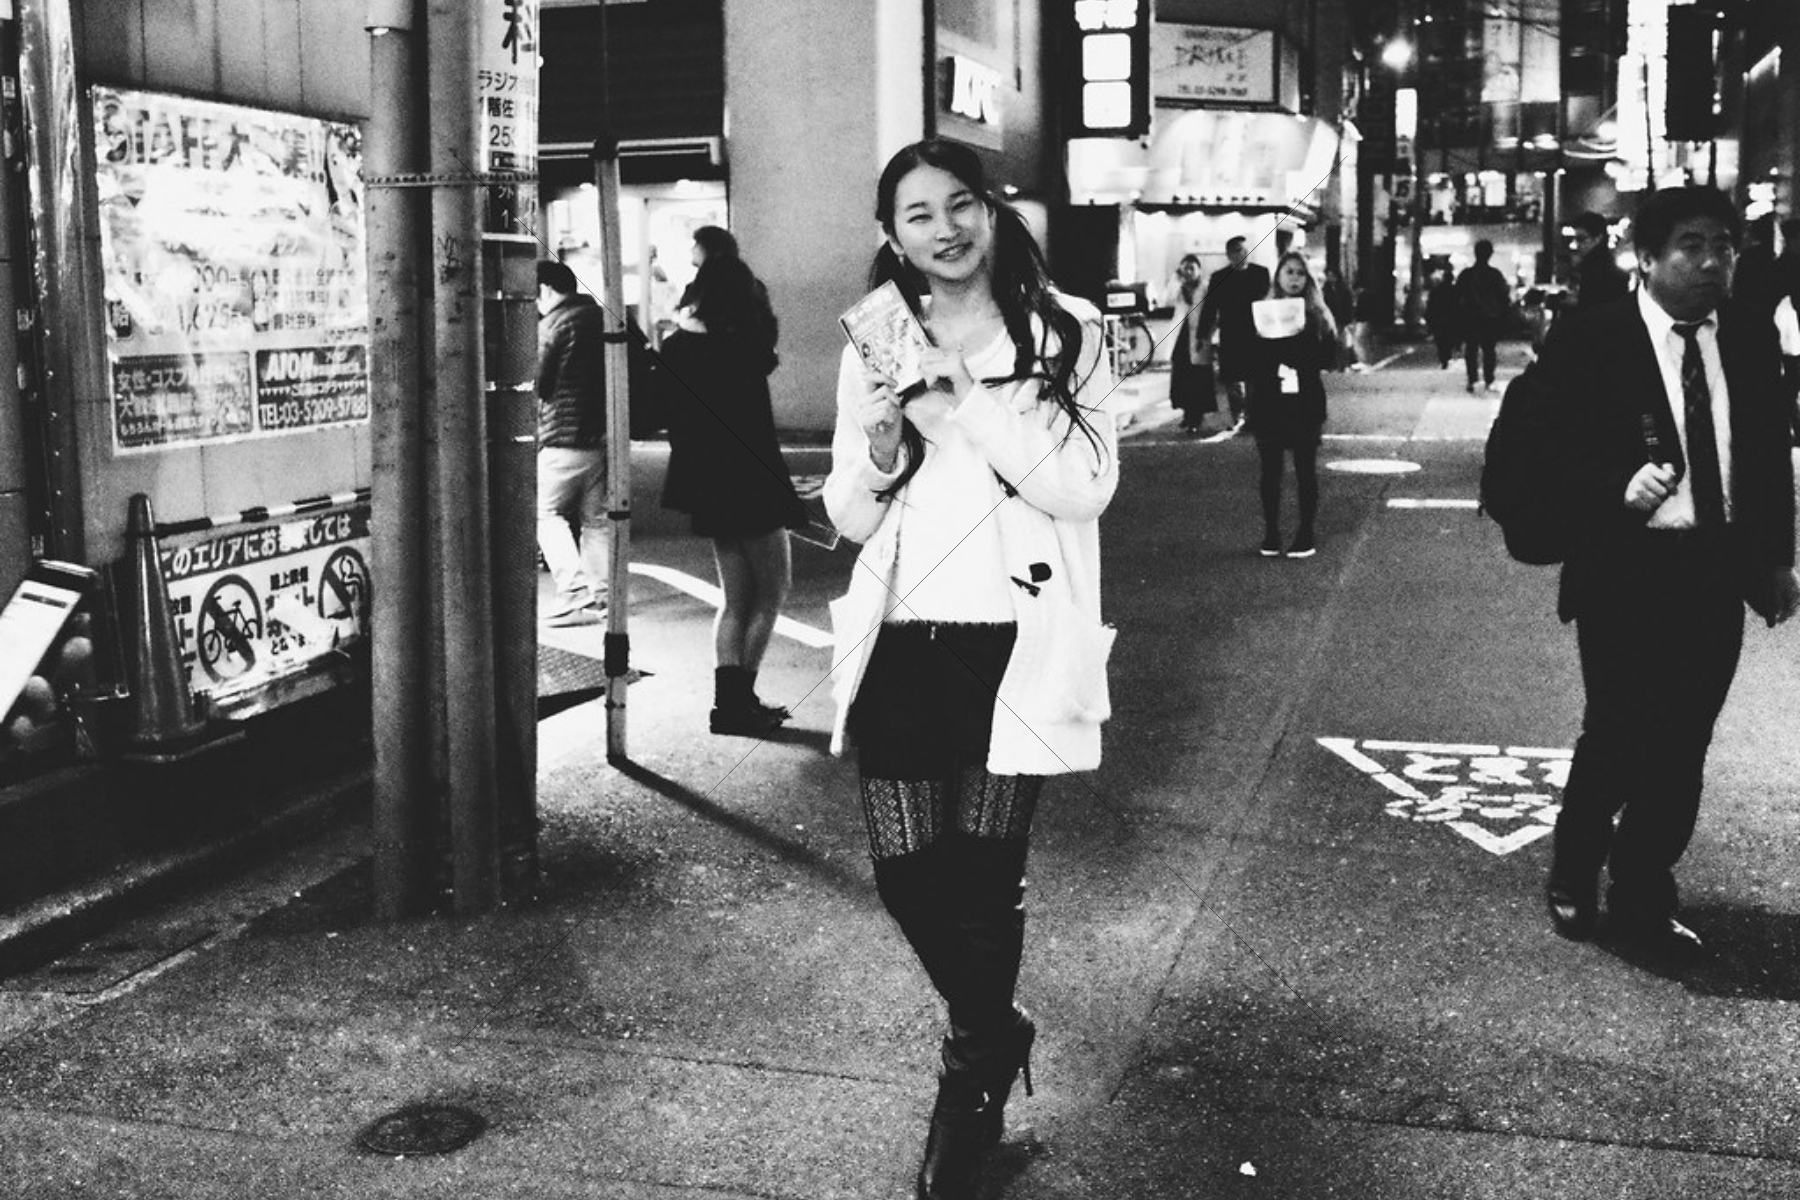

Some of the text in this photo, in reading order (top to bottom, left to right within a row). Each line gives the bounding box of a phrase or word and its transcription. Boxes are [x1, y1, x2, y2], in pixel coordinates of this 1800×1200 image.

[161, 513, 351, 578] このエリアにおしては
